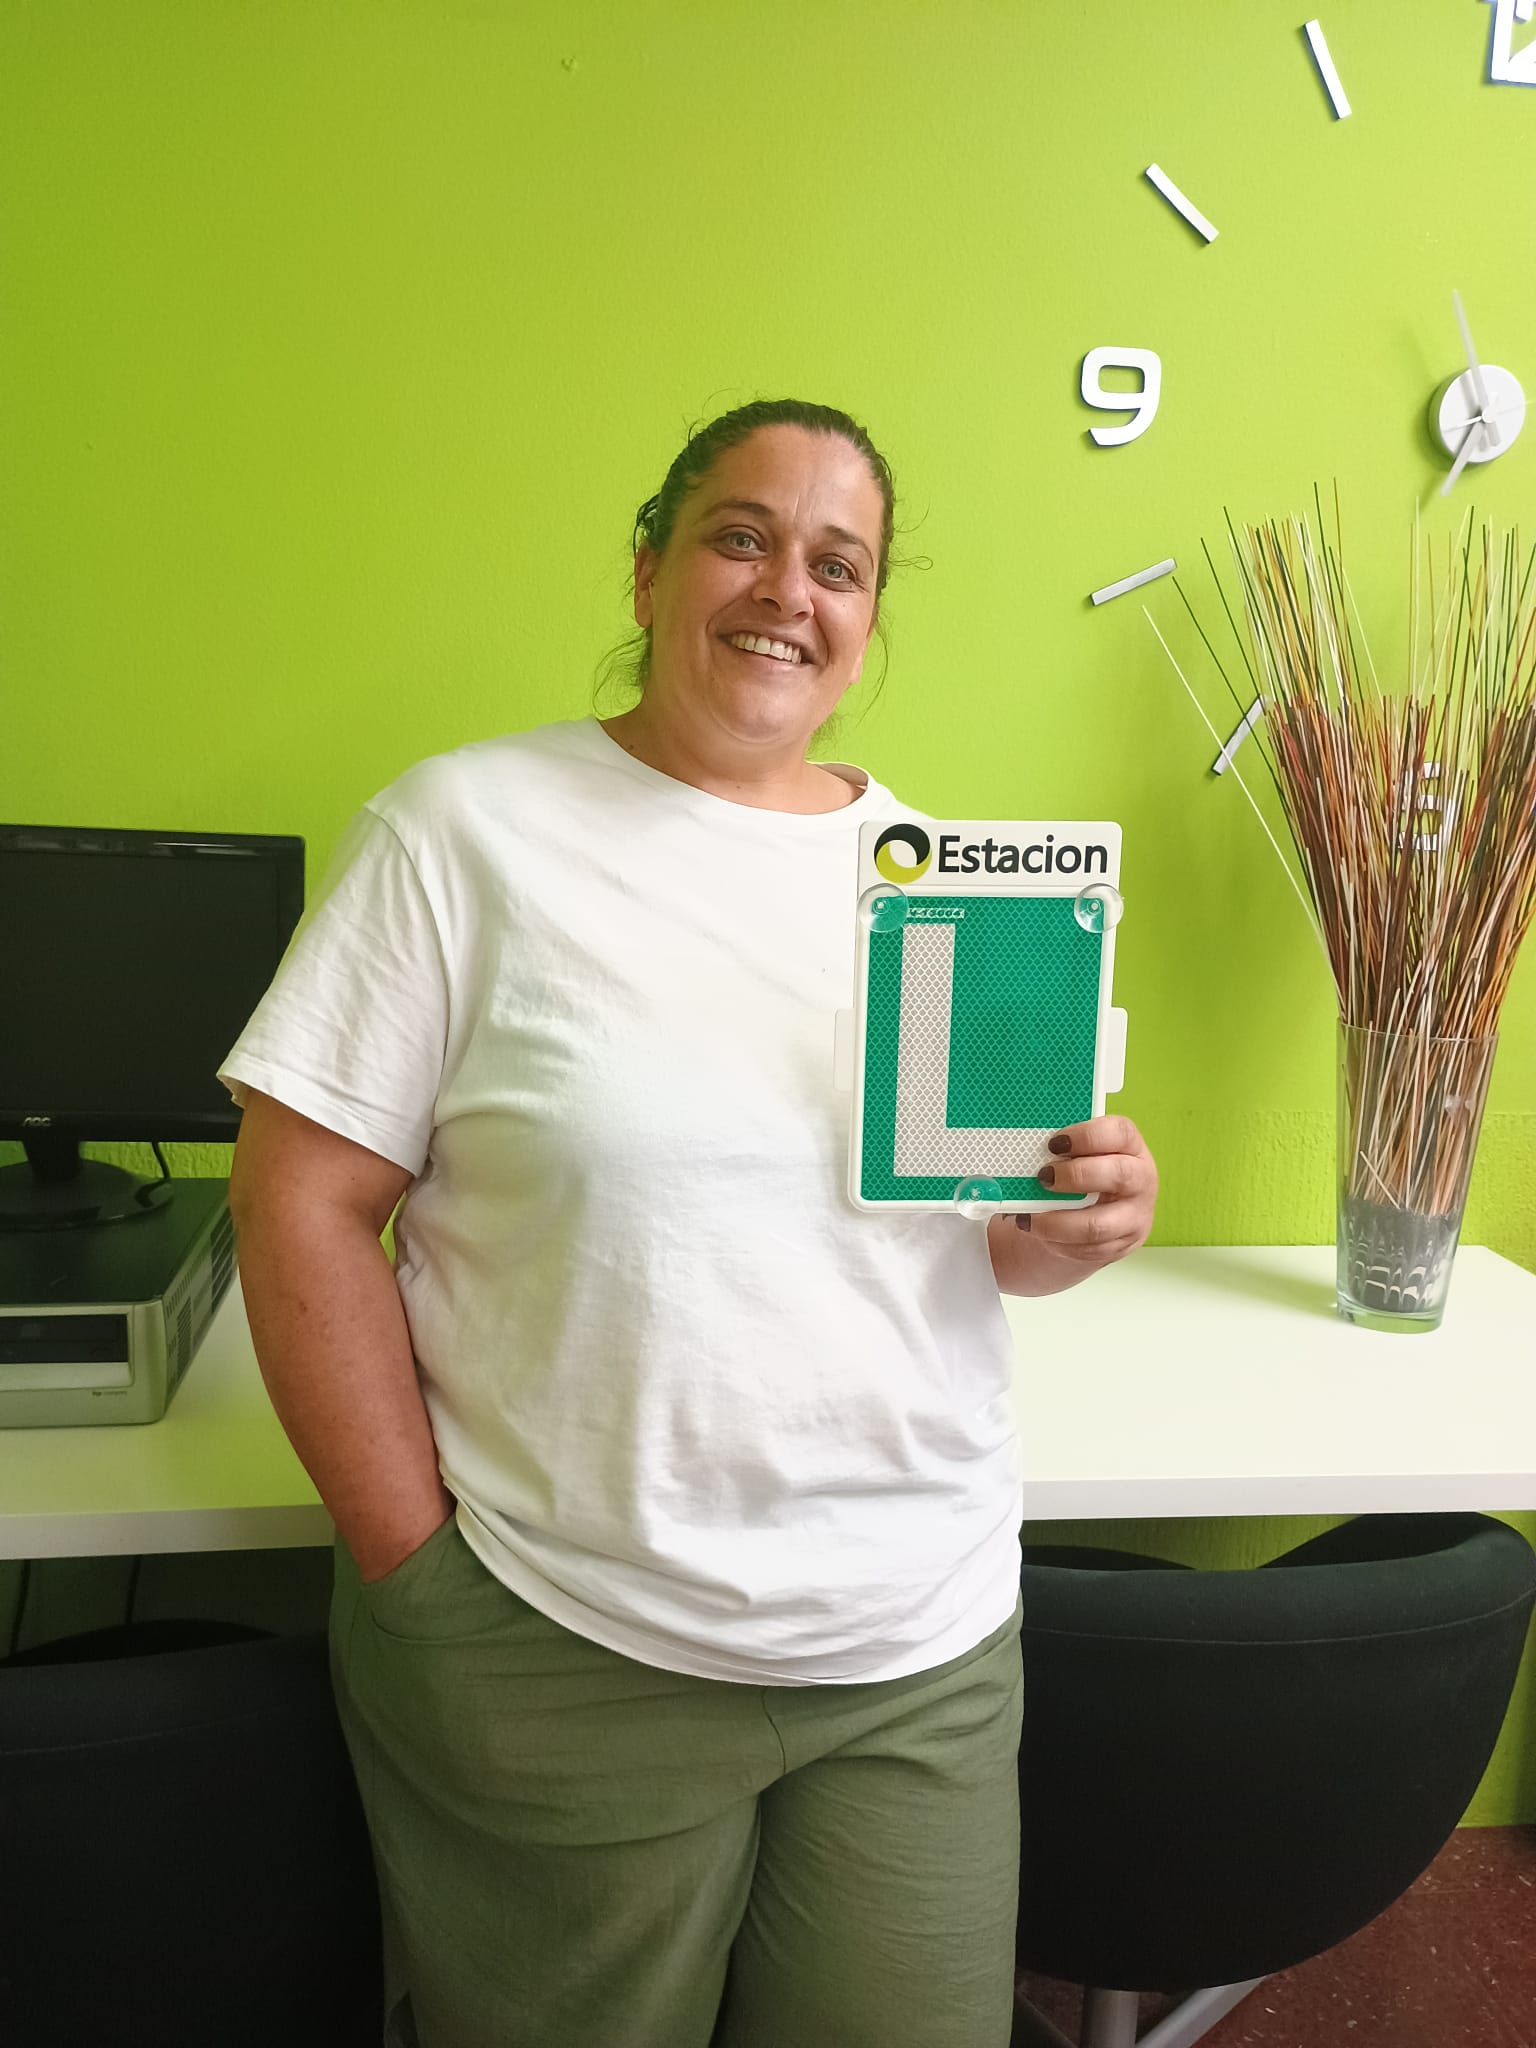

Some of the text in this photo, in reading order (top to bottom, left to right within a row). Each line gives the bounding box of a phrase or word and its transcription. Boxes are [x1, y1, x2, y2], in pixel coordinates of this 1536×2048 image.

[1080, 346, 1162, 446] 9
[938, 834, 1108, 874] Estacion
[893, 923, 1068, 1177] L
